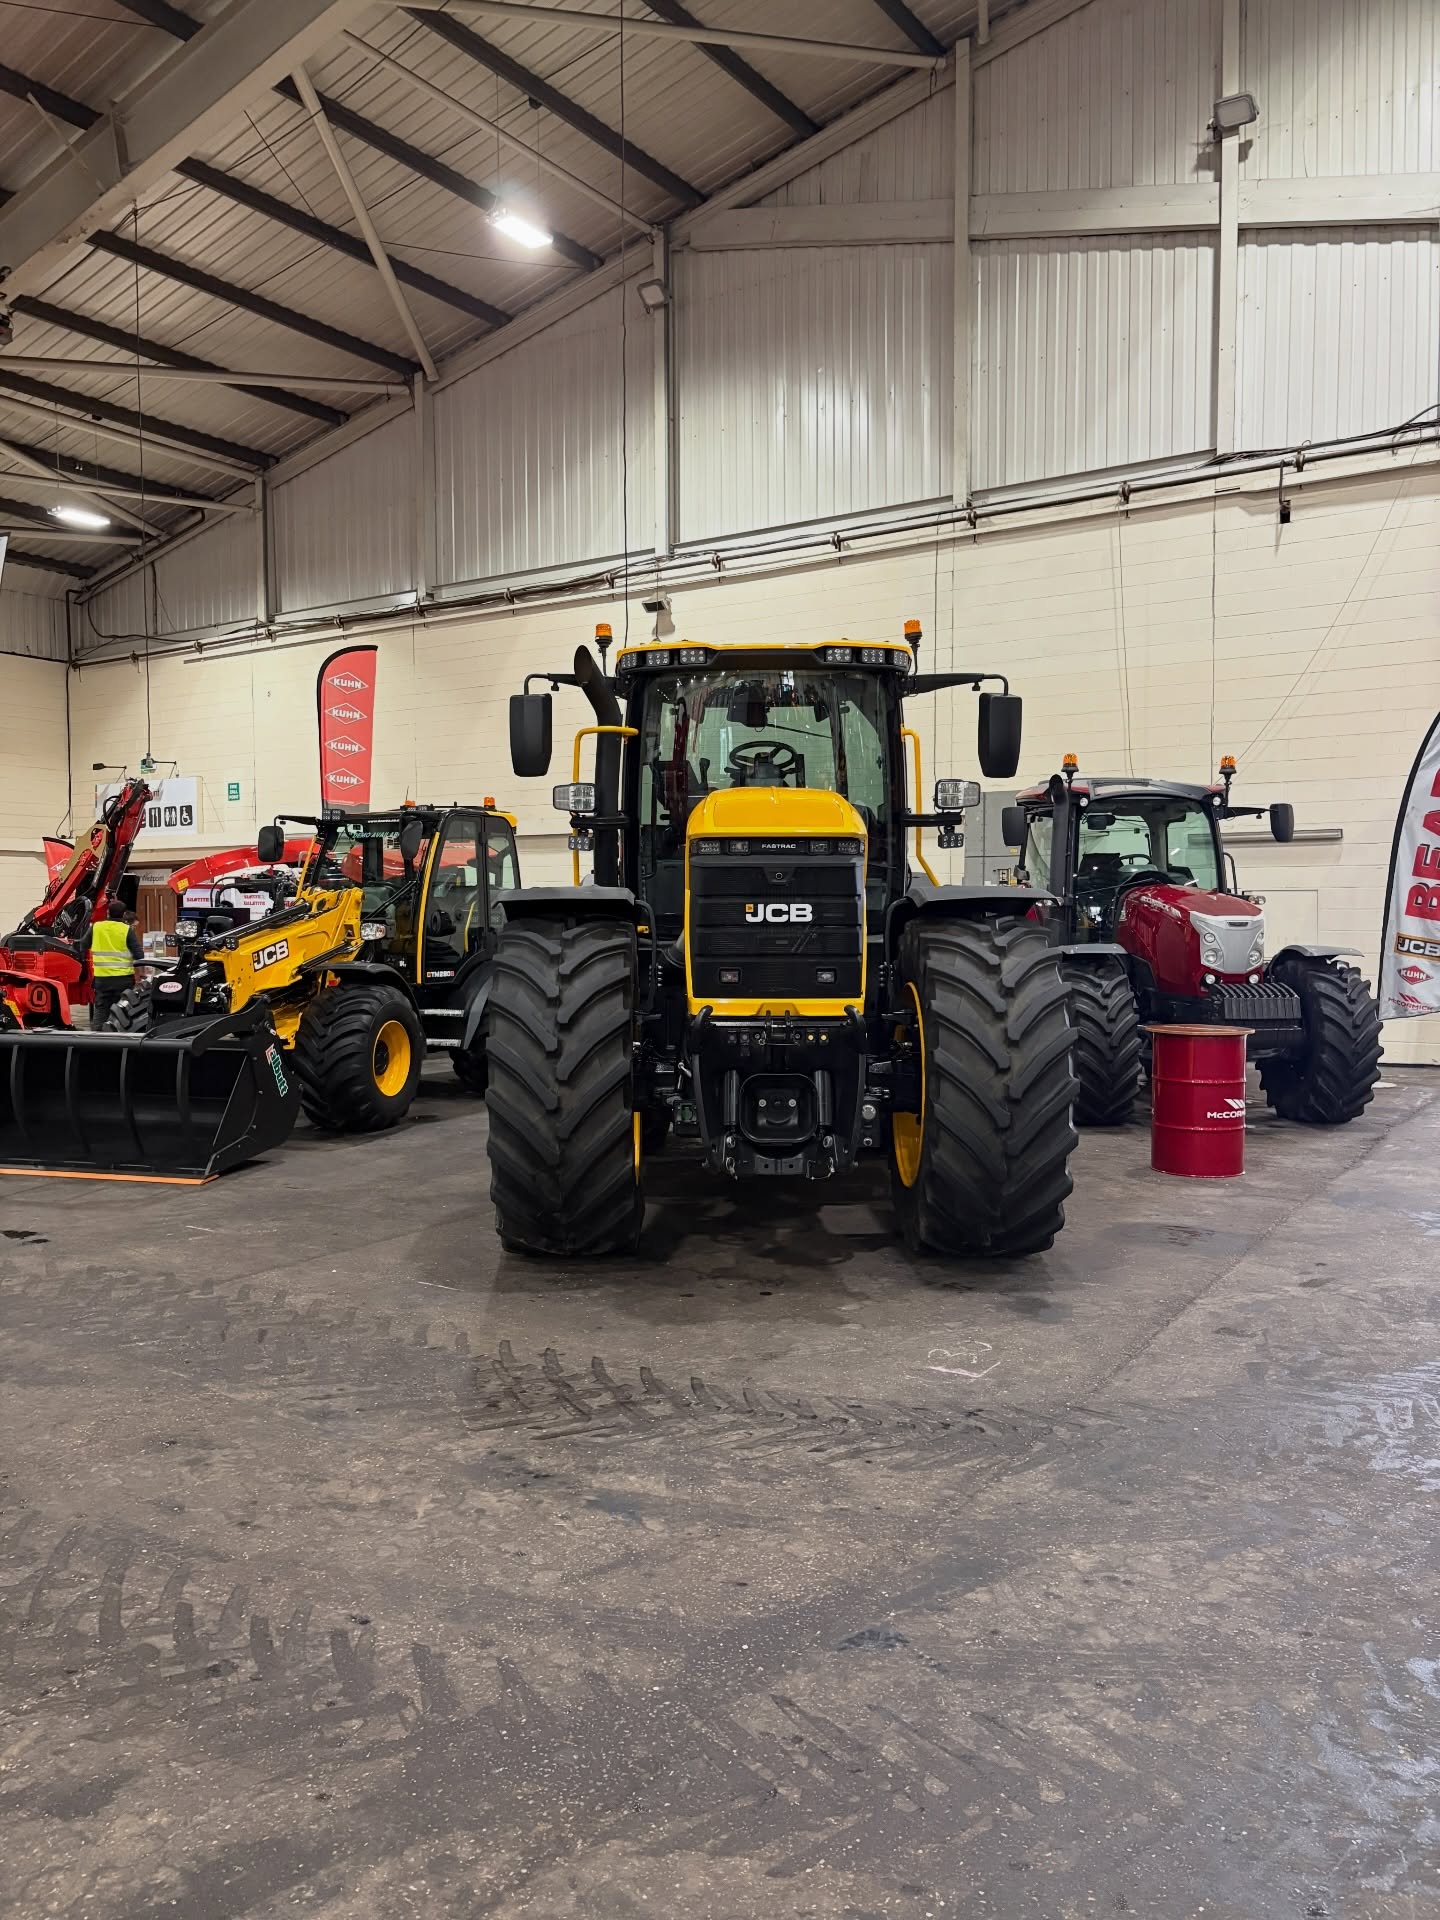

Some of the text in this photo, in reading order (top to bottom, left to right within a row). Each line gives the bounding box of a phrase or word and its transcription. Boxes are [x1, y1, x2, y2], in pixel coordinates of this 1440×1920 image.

[333, 677, 361, 689] KUHN
[332, 708, 360, 720] KUHN
[330, 741, 358, 752] KUHN
[328, 773, 357, 785] KUHN
[745, 903, 813, 923] JCB
[1398, 937, 1440, 957] JCB
[254, 940, 289, 970] JCB
[1400, 969, 1427, 981] KUHN
[1388, 997, 1433, 1011] McCORMICK
